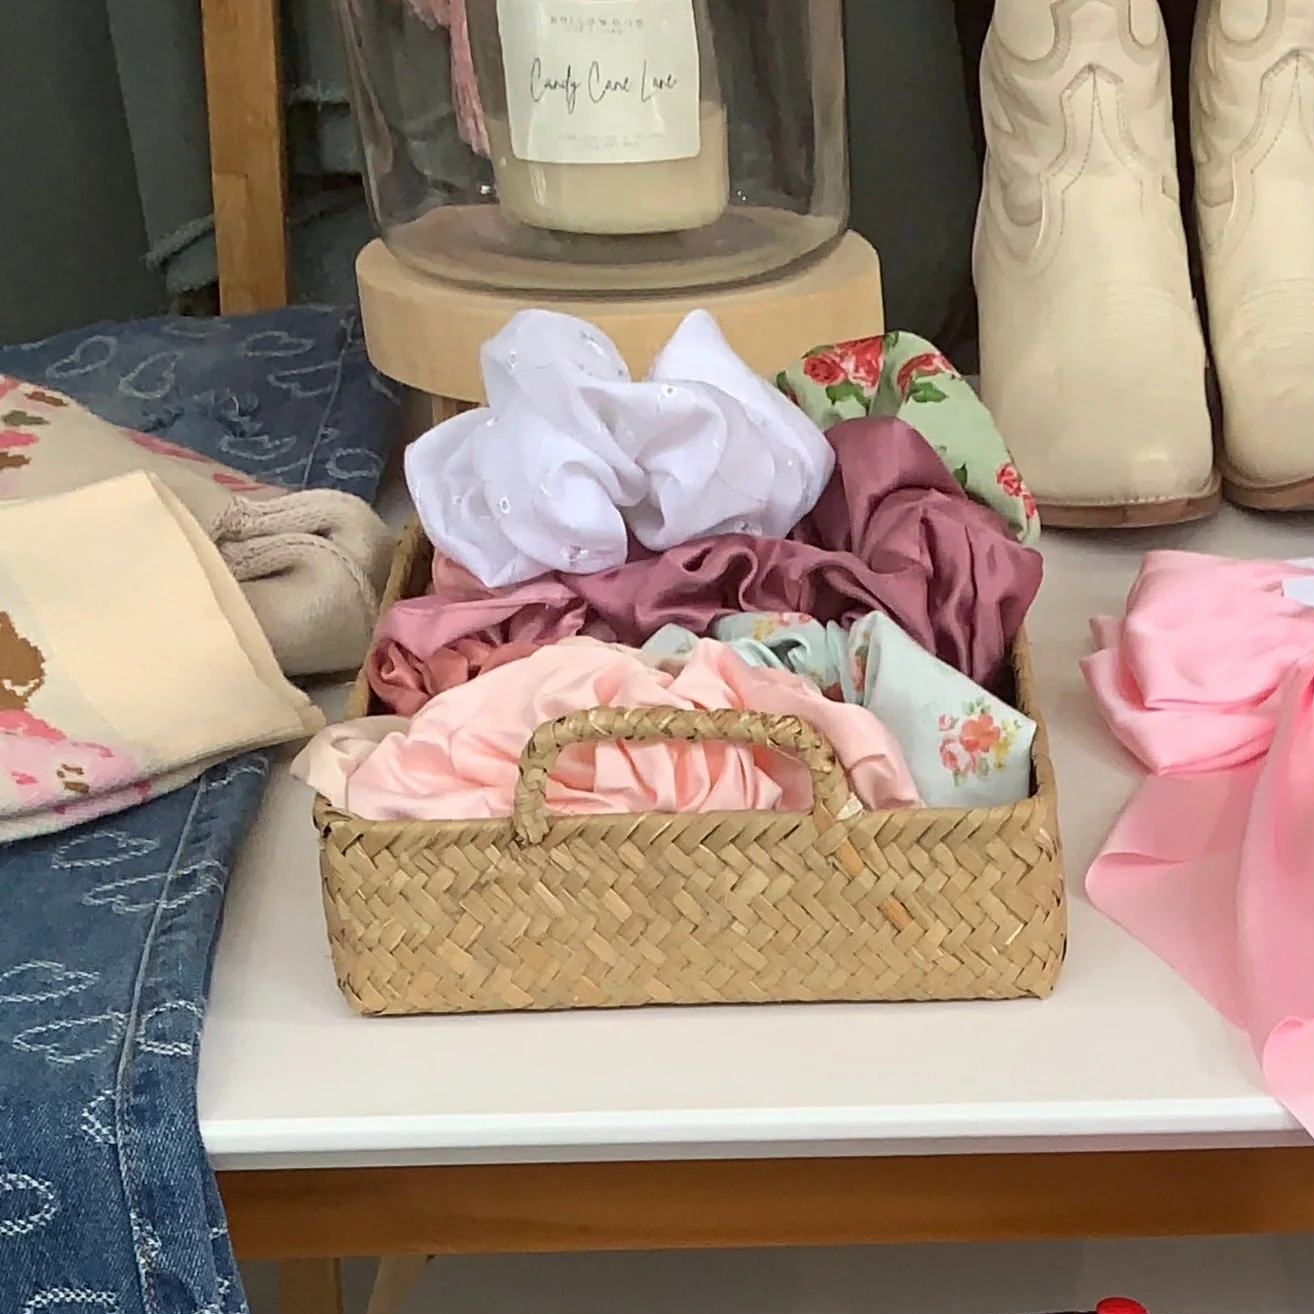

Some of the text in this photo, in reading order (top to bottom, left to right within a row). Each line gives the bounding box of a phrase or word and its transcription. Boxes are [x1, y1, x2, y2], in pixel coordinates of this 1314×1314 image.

[530, 57, 677, 114] Candy Cane Lane
